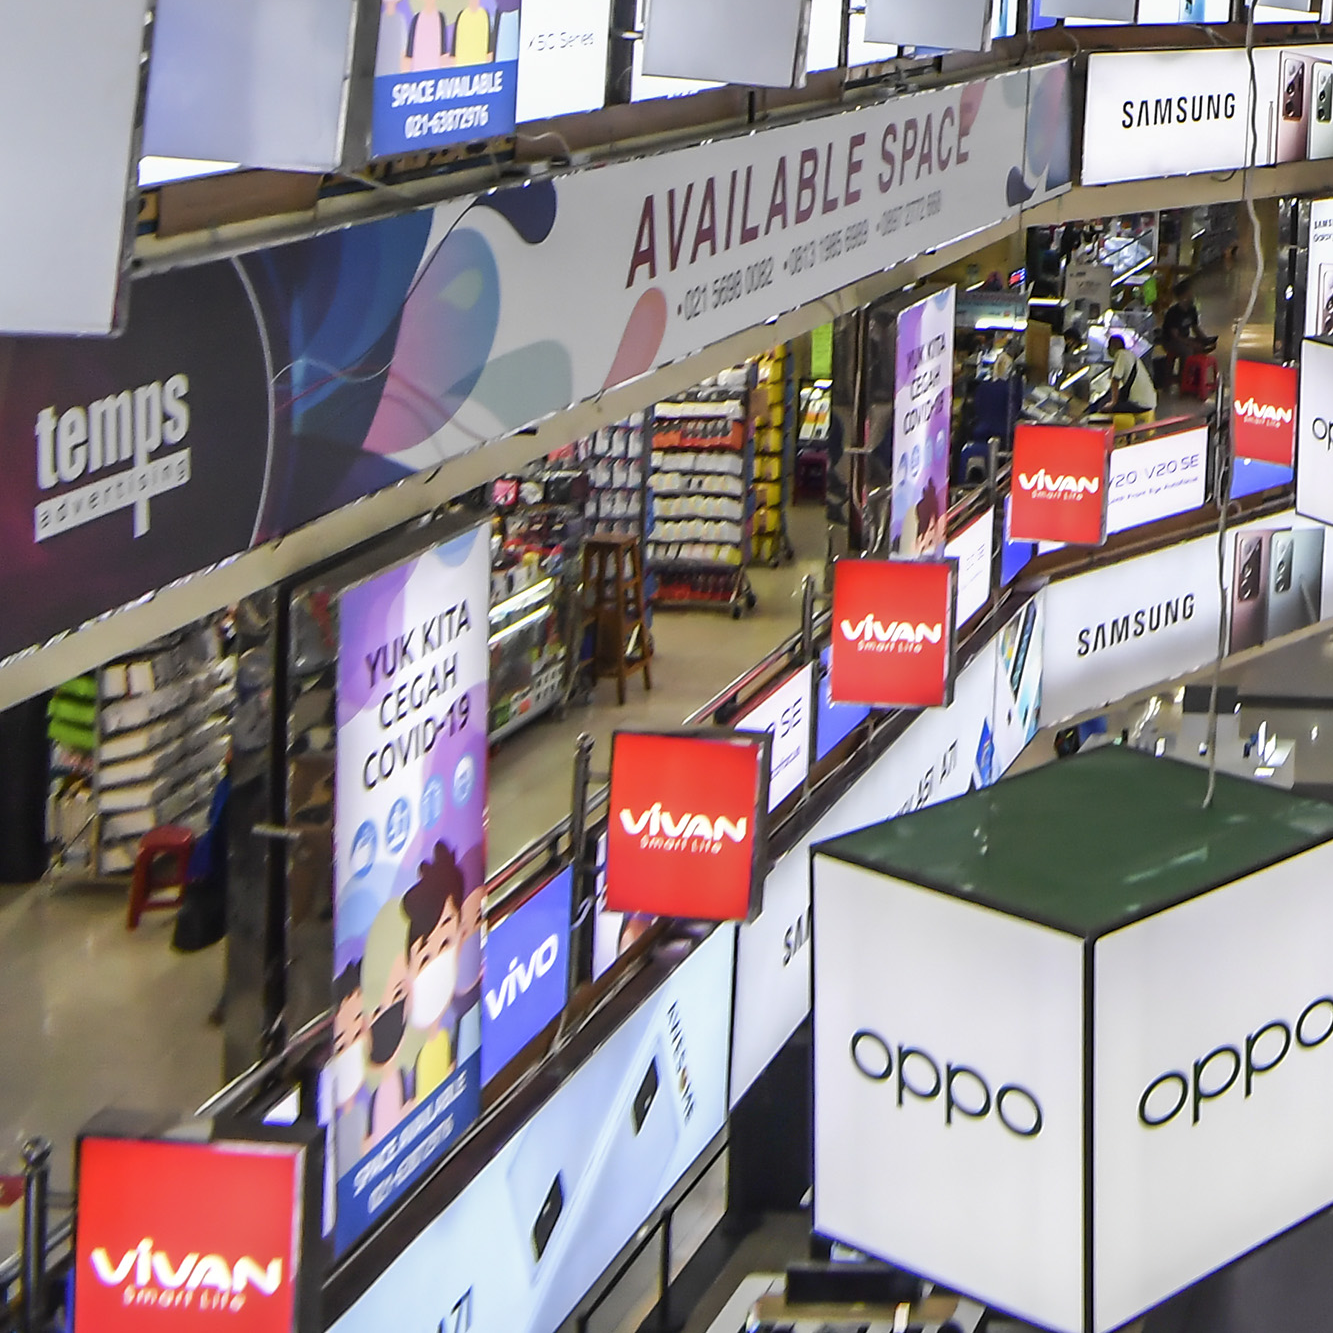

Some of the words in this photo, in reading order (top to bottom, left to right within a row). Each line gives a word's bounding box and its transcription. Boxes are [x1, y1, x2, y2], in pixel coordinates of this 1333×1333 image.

[392, 79, 435, 107] SPACE
[435, 70, 503, 100] AVAILABLE
[1121, 93, 1236, 128] SAMSUNG
[626, 132, 866, 289] AVAILABLE
[878, 103, 975, 194] SPACE
[35, 374, 190, 539] temps
[1180, 453, 1201, 471] SE
[364, 634, 414, 689] YUK
[421, 599, 472, 660] KITA
[1078, 593, 1195, 658] SAMSUNG
[379, 652, 458, 730] CEGAH
[362, 692, 472, 790] COVID-19
[484, 933, 560, 1021] vivo
[849, 1027, 1043, 1138] oppo
